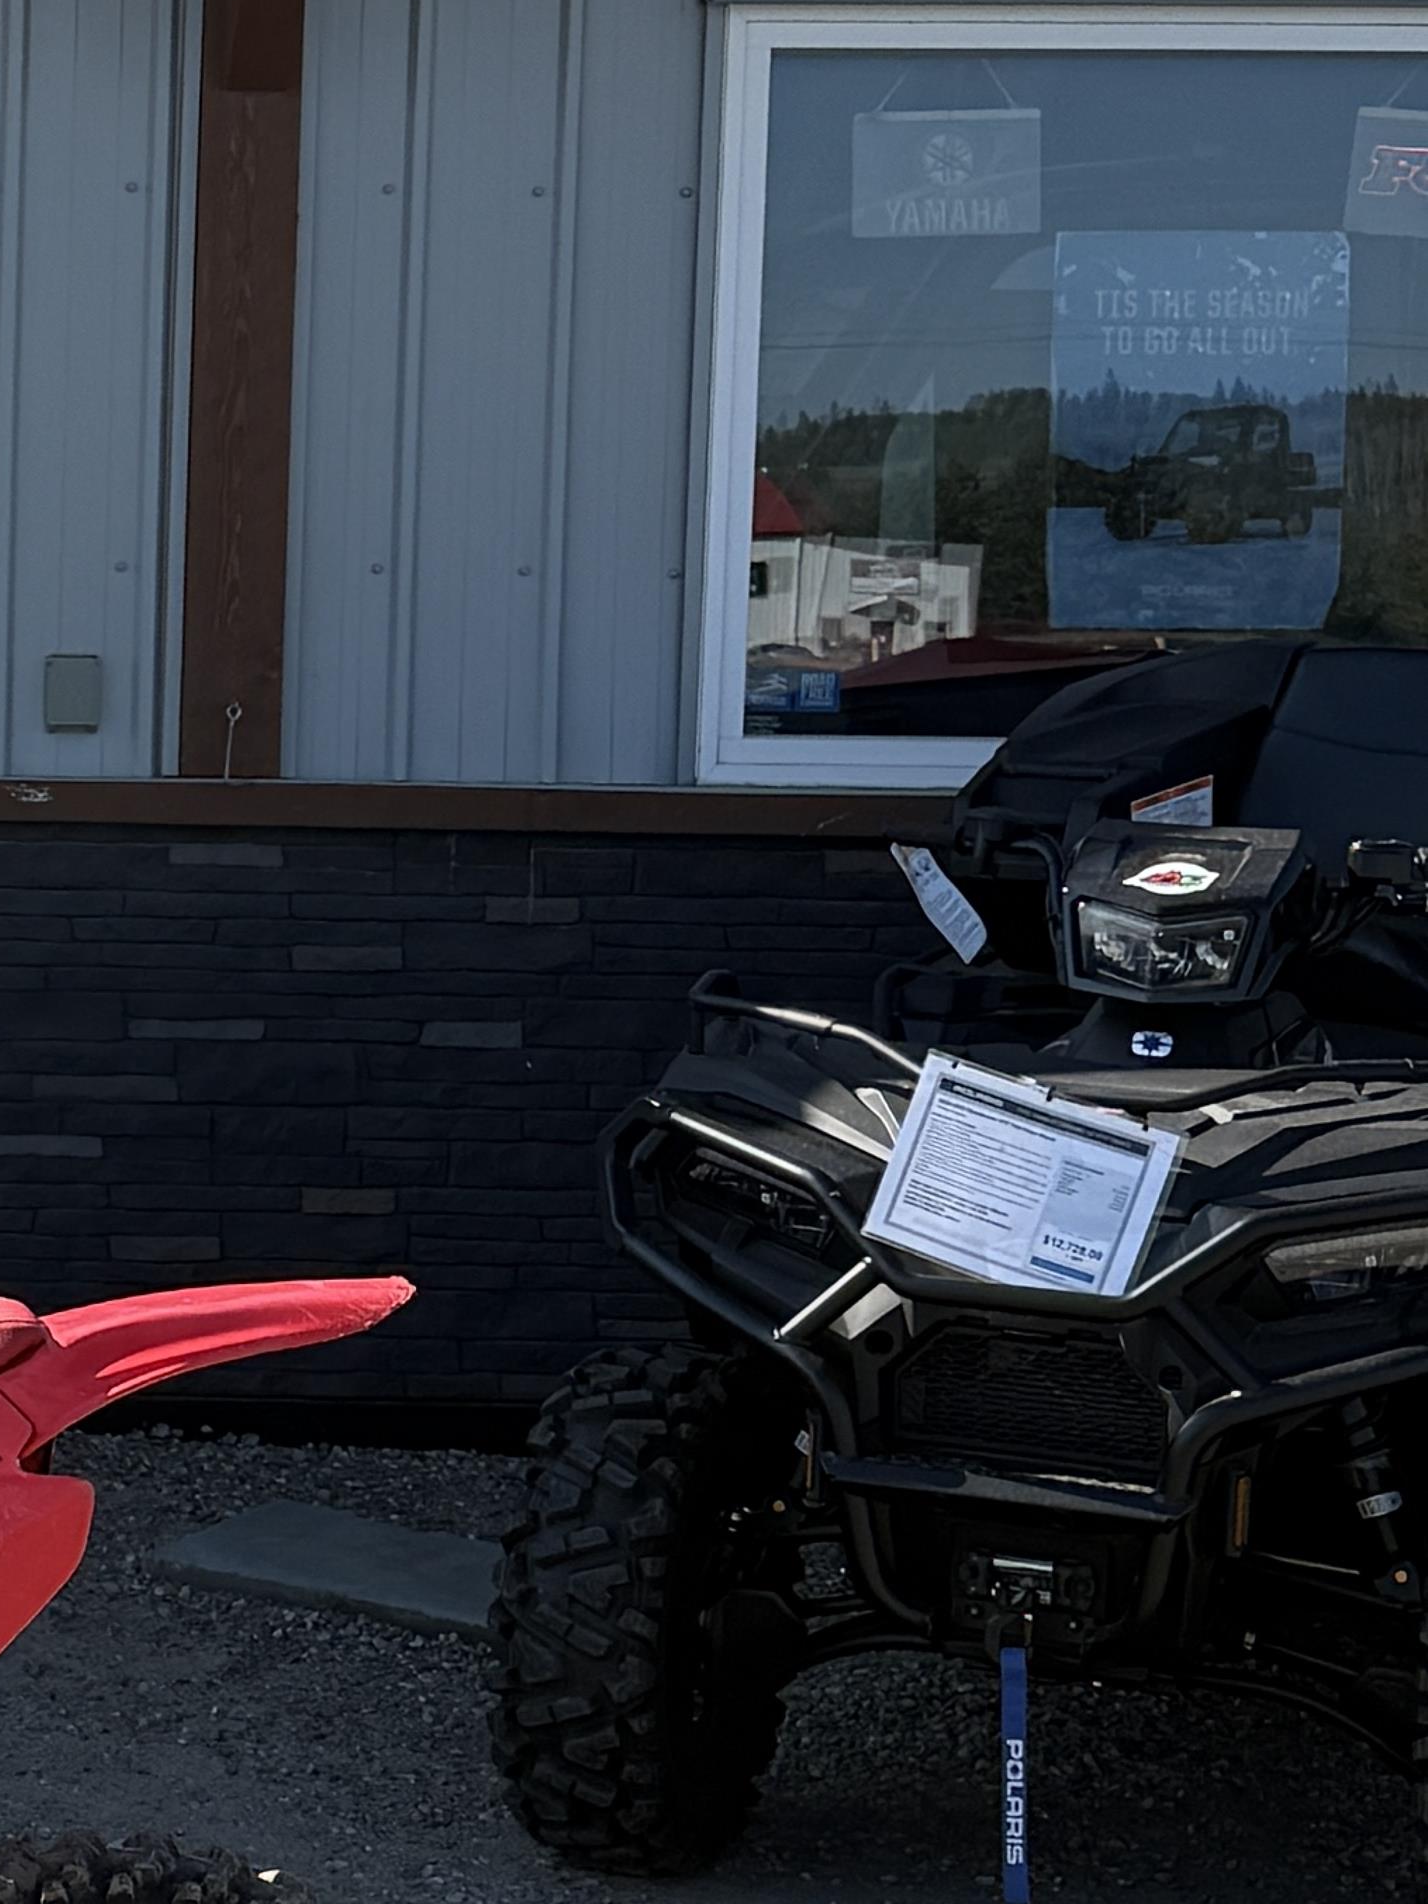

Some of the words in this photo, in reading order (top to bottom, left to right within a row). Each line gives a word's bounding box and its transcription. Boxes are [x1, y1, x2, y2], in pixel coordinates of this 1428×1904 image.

[886, 198, 1009, 232] YAMAHA
[1094, 289, 1138, 318] TIS
[1148, 289, 1196, 318] THE
[1208, 289, 1309, 318] SEASON
[1101, 326, 1133, 356] TO
[1145, 326, 1180, 356] GO
[1187, 326, 1233, 356] ALL
[1006, 1739, 1024, 1865] POLARIS
